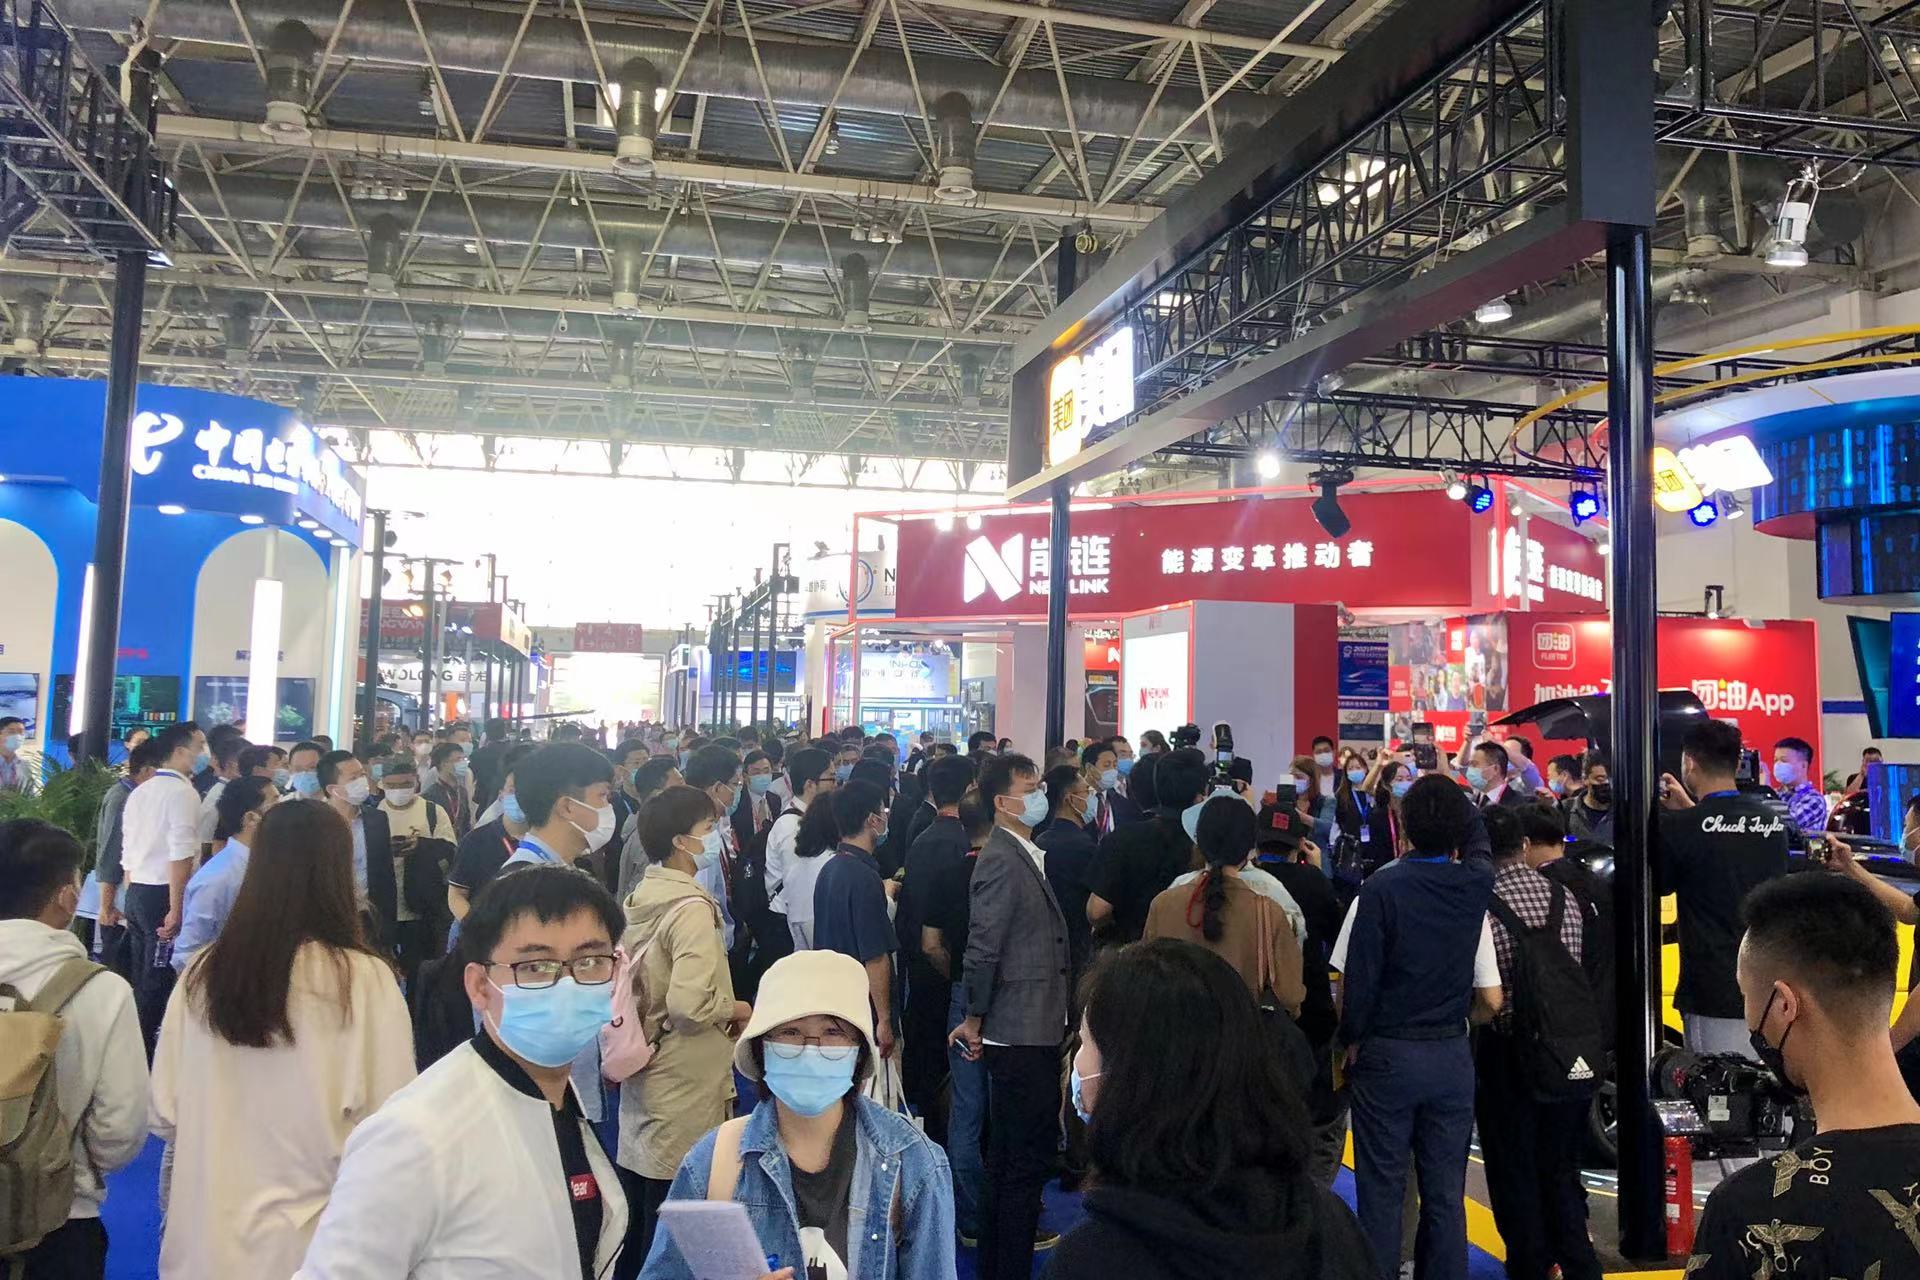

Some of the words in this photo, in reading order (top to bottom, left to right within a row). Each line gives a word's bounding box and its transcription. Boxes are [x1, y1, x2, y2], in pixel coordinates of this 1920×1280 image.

[1053, 389, 1072, 436] 美团
[1161, 539, 1374, 574] 能源变革推动者
[1029, 578, 1110, 594] NELINK
[1702, 815, 1745, 833] Chuck
[1567, 1070, 1594, 1080] adidas
[1809, 1146, 1833, 1185] BOY
